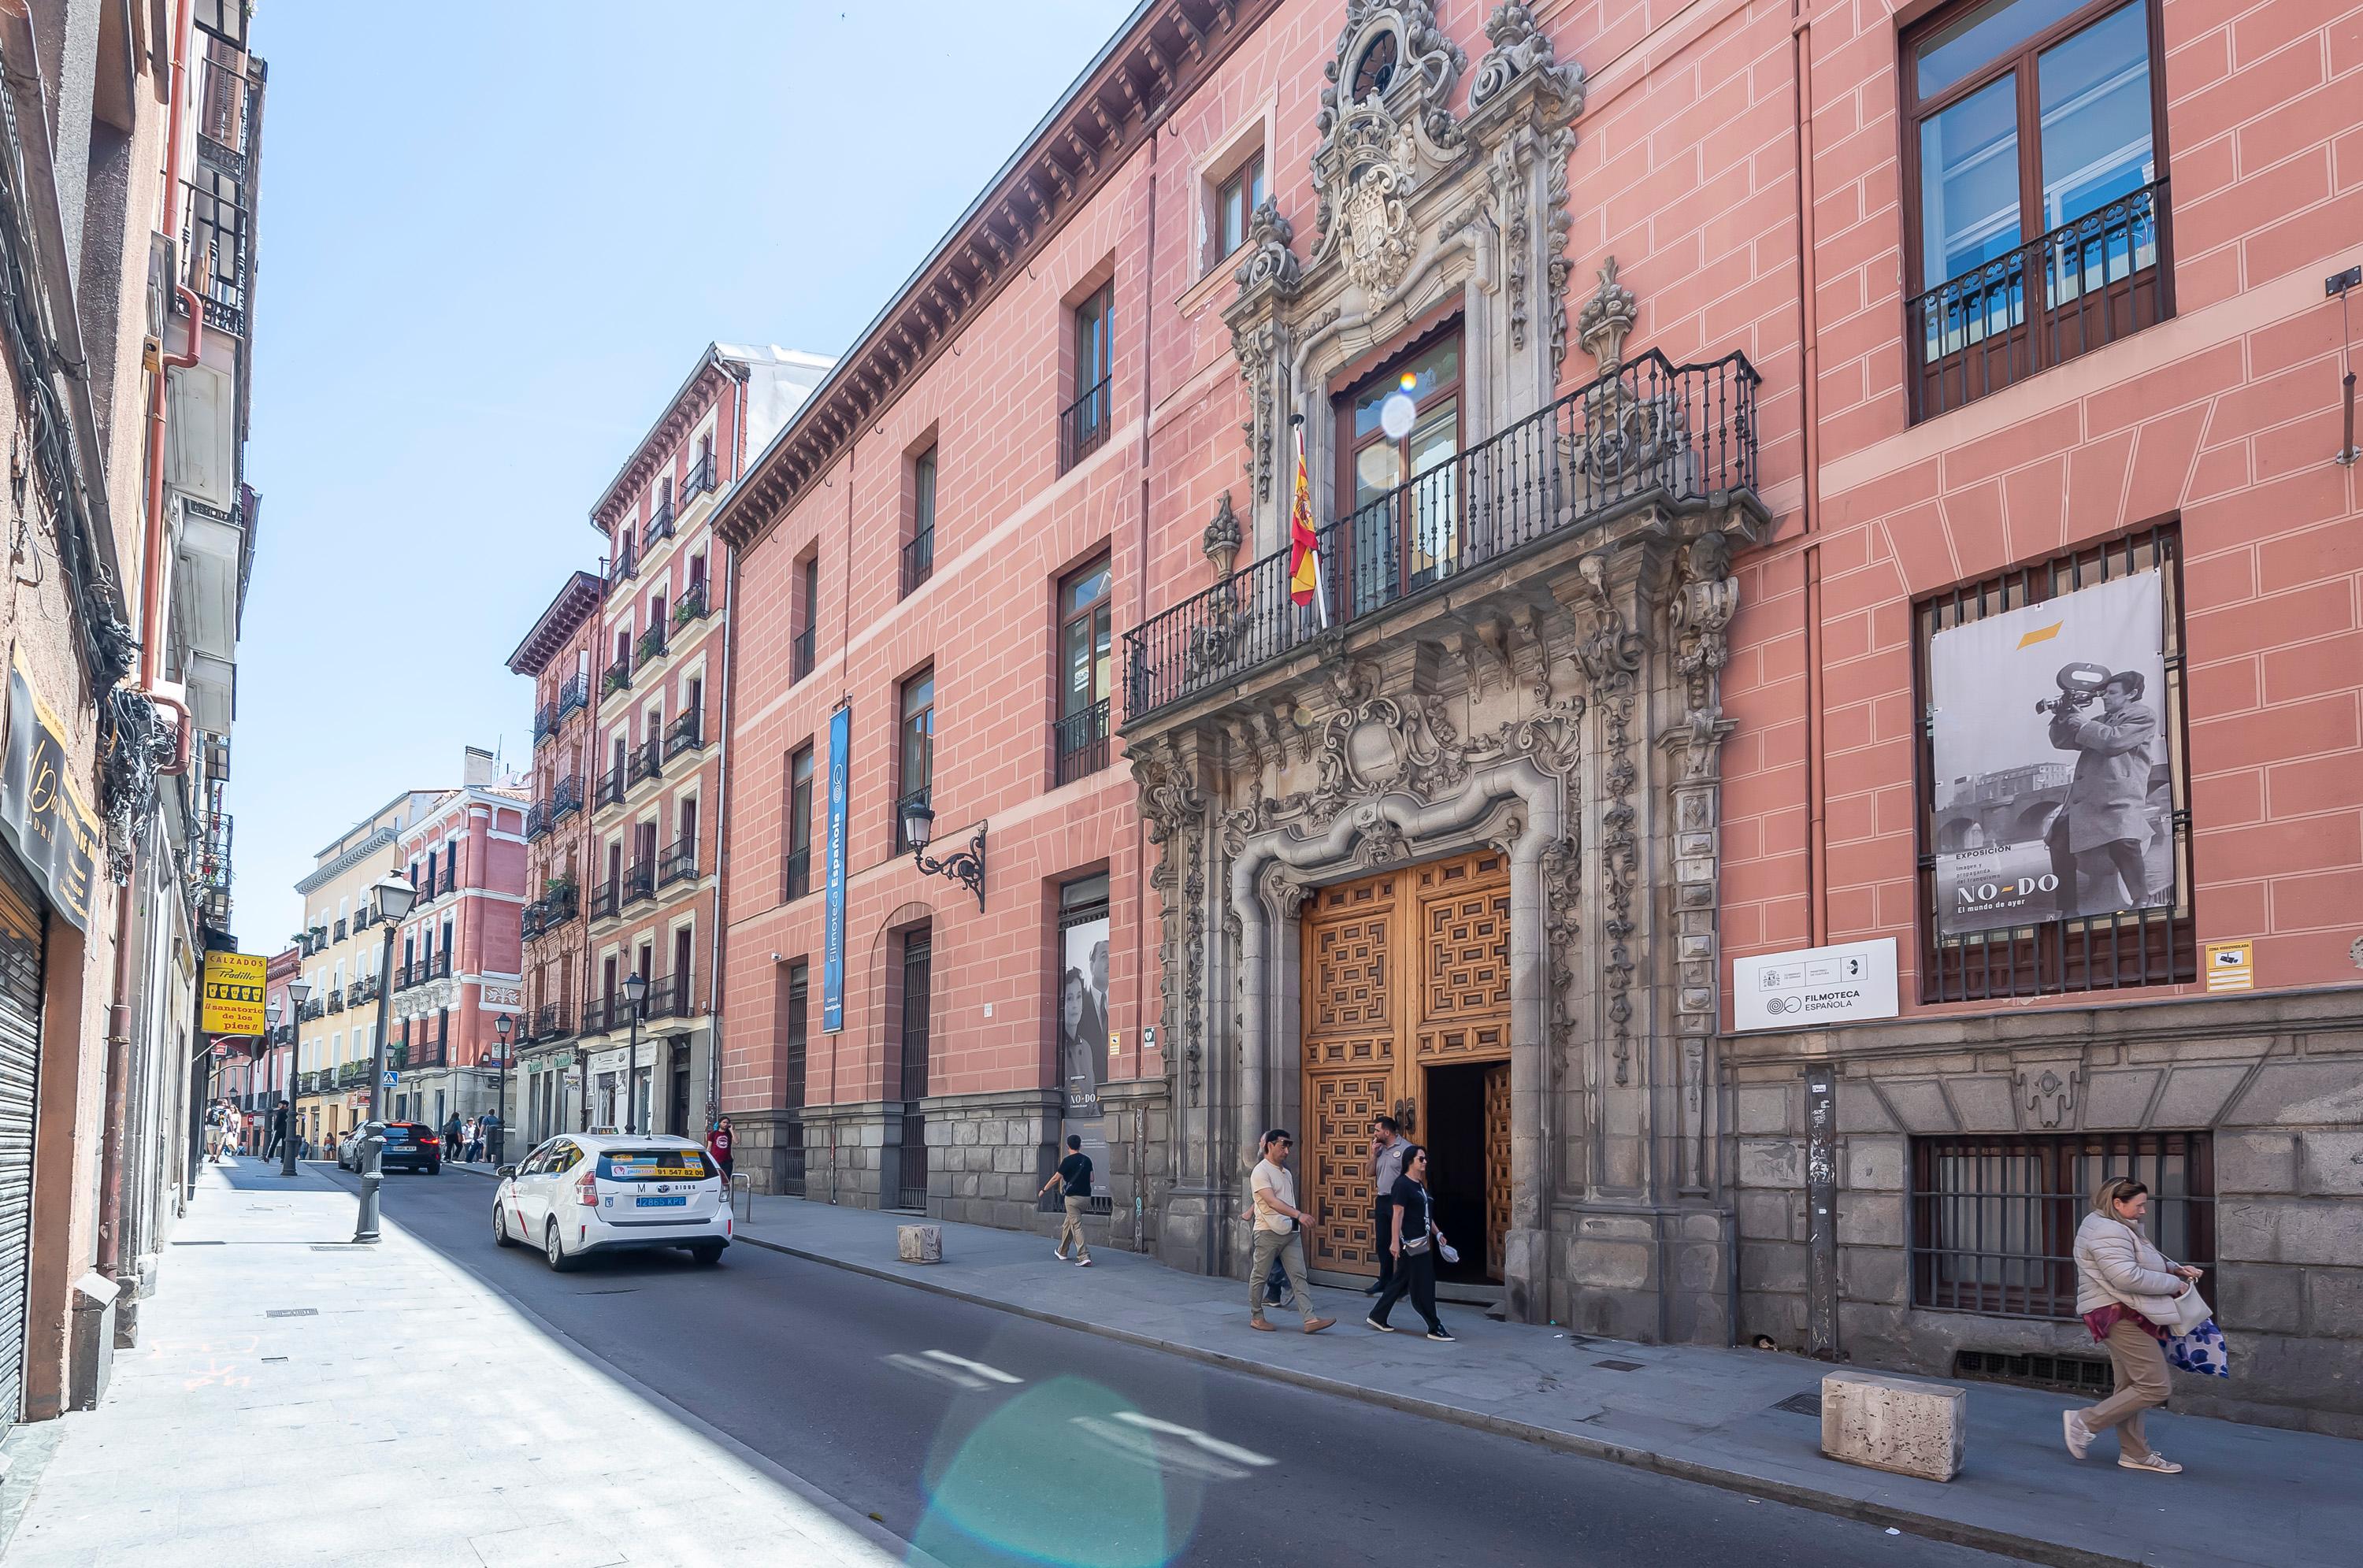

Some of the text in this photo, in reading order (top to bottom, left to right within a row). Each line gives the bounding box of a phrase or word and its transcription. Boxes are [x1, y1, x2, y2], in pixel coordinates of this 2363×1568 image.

[1956, 845, 2011, 860] EXPOSICIÓN
[1957, 869, 1990, 878] propaganda
[1968, 903, 1993, 912] mundo
[2008, 899, 2026, 908] ayer
[829, 891, 838, 962] Filmoteca
[210, 955, 263, 967] CALZADOS
[1805, 990, 1860, 1003] FILMOTECA
[1805, 999, 1853, 1011] ESPAÑOLA
[637, 1184, 646, 1193] M
[642, 1198, 665, 1207] 2865
